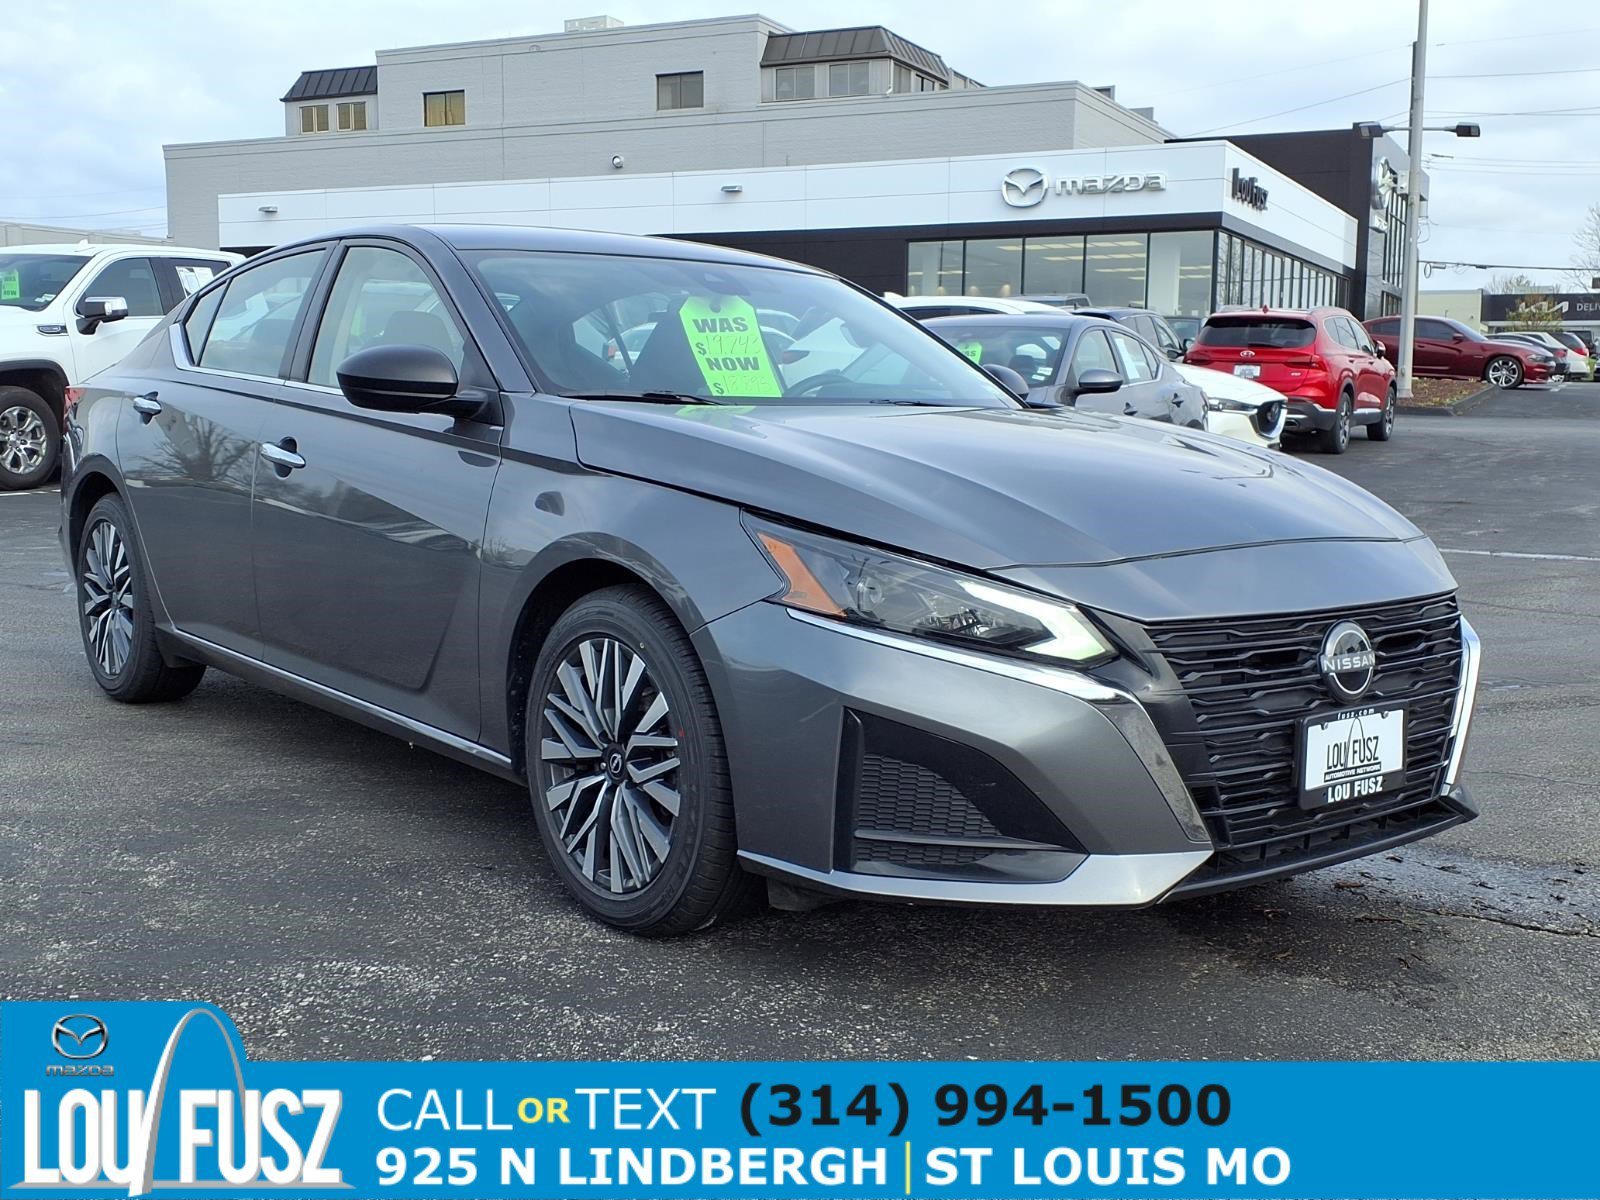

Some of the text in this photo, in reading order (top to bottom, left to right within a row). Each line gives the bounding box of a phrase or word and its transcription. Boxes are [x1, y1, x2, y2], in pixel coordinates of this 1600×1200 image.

[692, 317, 749, 334] WAS
[705, 356, 761, 372] NOW
[1323, 653, 1376, 672] NISSAN
[1326, 735, 1380, 770] LOU FUSZ
[1327, 775, 1384, 803] LOU FUSZ
